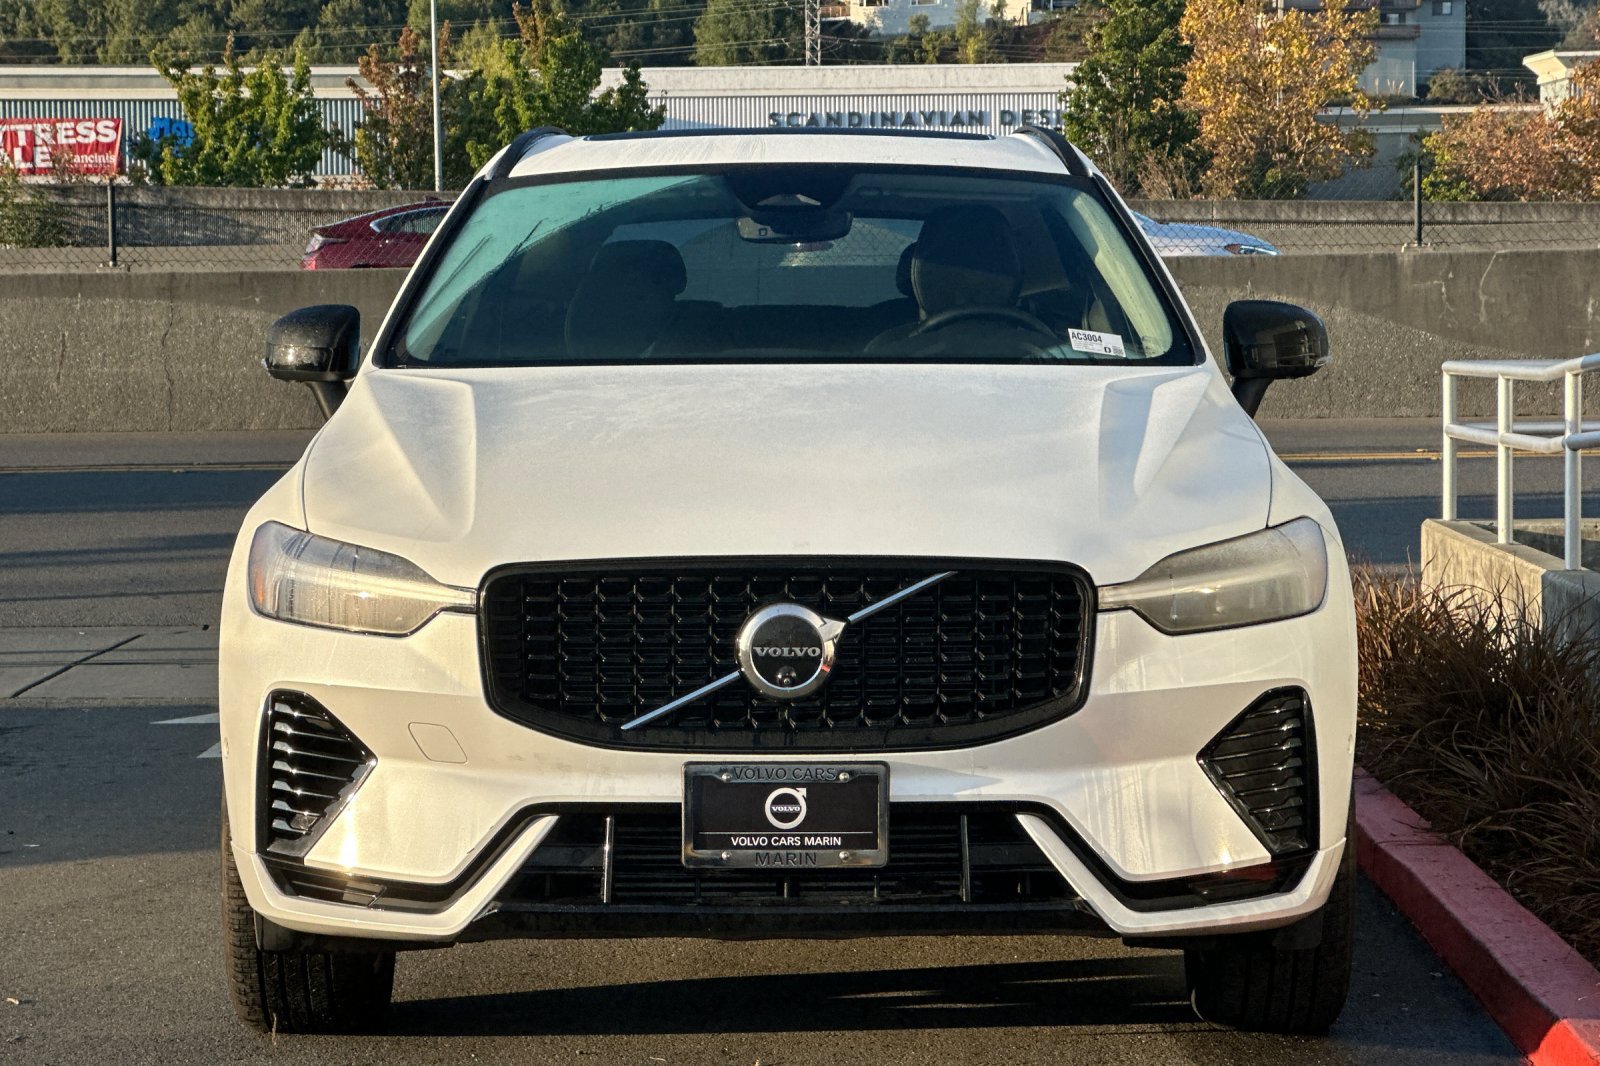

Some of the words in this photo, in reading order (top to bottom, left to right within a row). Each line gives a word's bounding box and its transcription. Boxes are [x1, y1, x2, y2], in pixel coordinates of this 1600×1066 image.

[768, 110, 985, 127] SCANDINAVIAN
[1071, 331, 1103, 343] AC3004
[753, 647, 821, 657] VOLVO
[734, 767, 787, 780] VOLVO
[792, 767, 836, 780] CARS
[731, 836, 768, 846] VOLVO
[771, 836, 801, 846] CARS
[804, 836, 842, 846] MARIN
[755, 852, 817, 866] MARIN
